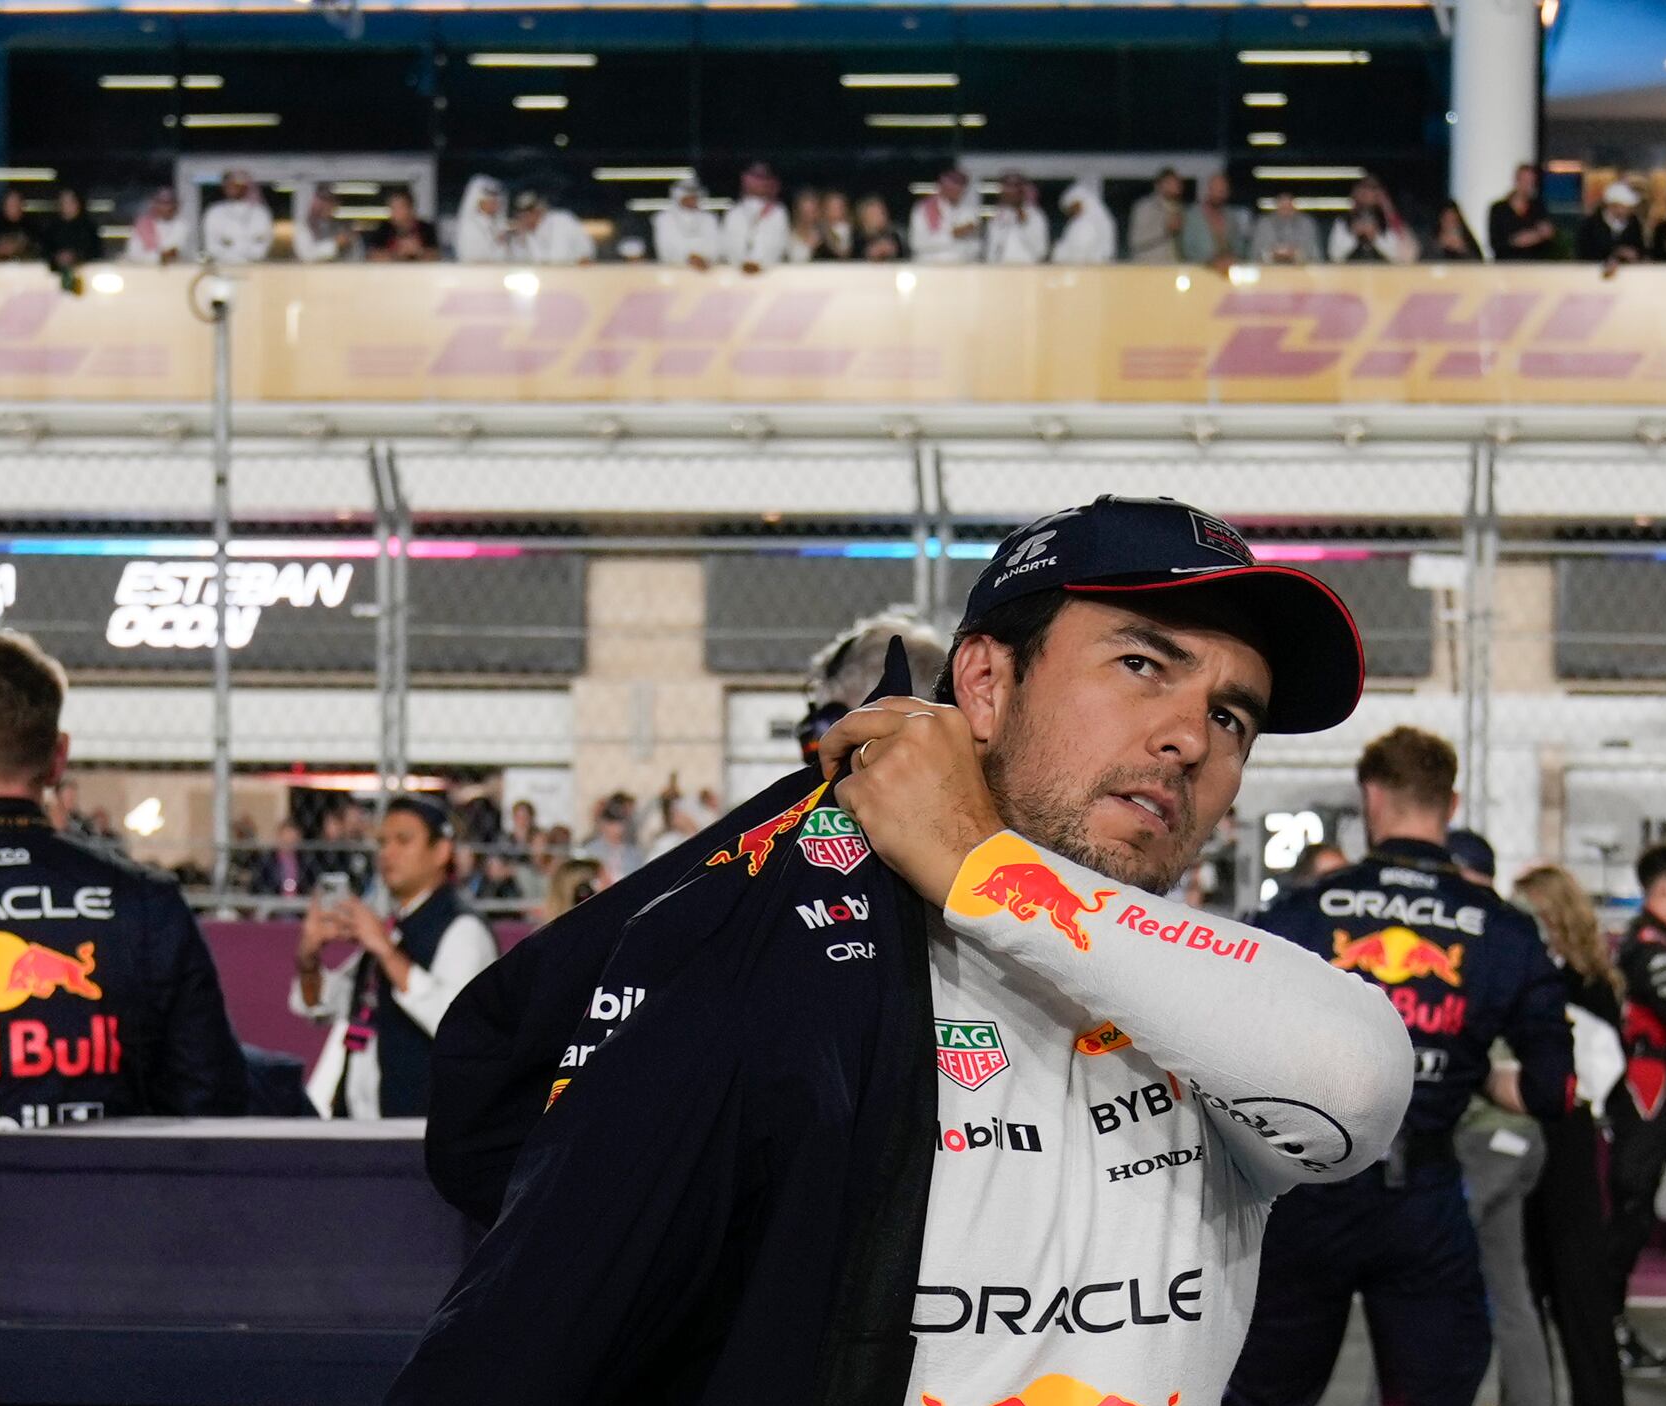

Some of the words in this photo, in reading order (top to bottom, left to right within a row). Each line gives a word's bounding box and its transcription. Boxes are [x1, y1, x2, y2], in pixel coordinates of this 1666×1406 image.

[428, 292, 854, 376] DHL
[1207, 293, 1641, 379] DHL
[114, 561, 354, 608] ESTEBAN
[994, 556, 1058, 588] BANORTE
[105, 605, 261, 649] OCON
[1117, 905, 1189, 944] Red
[1186, 924, 1261, 964] Bull
[1320, 889, 1486, 936] ORACLE
[8, 1013, 122, 1079] Bull
[935, 1024, 995, 1048] TAG
[937, 1116, 1004, 1152] obil
[910, 1268, 1203, 1335] ORACLE
